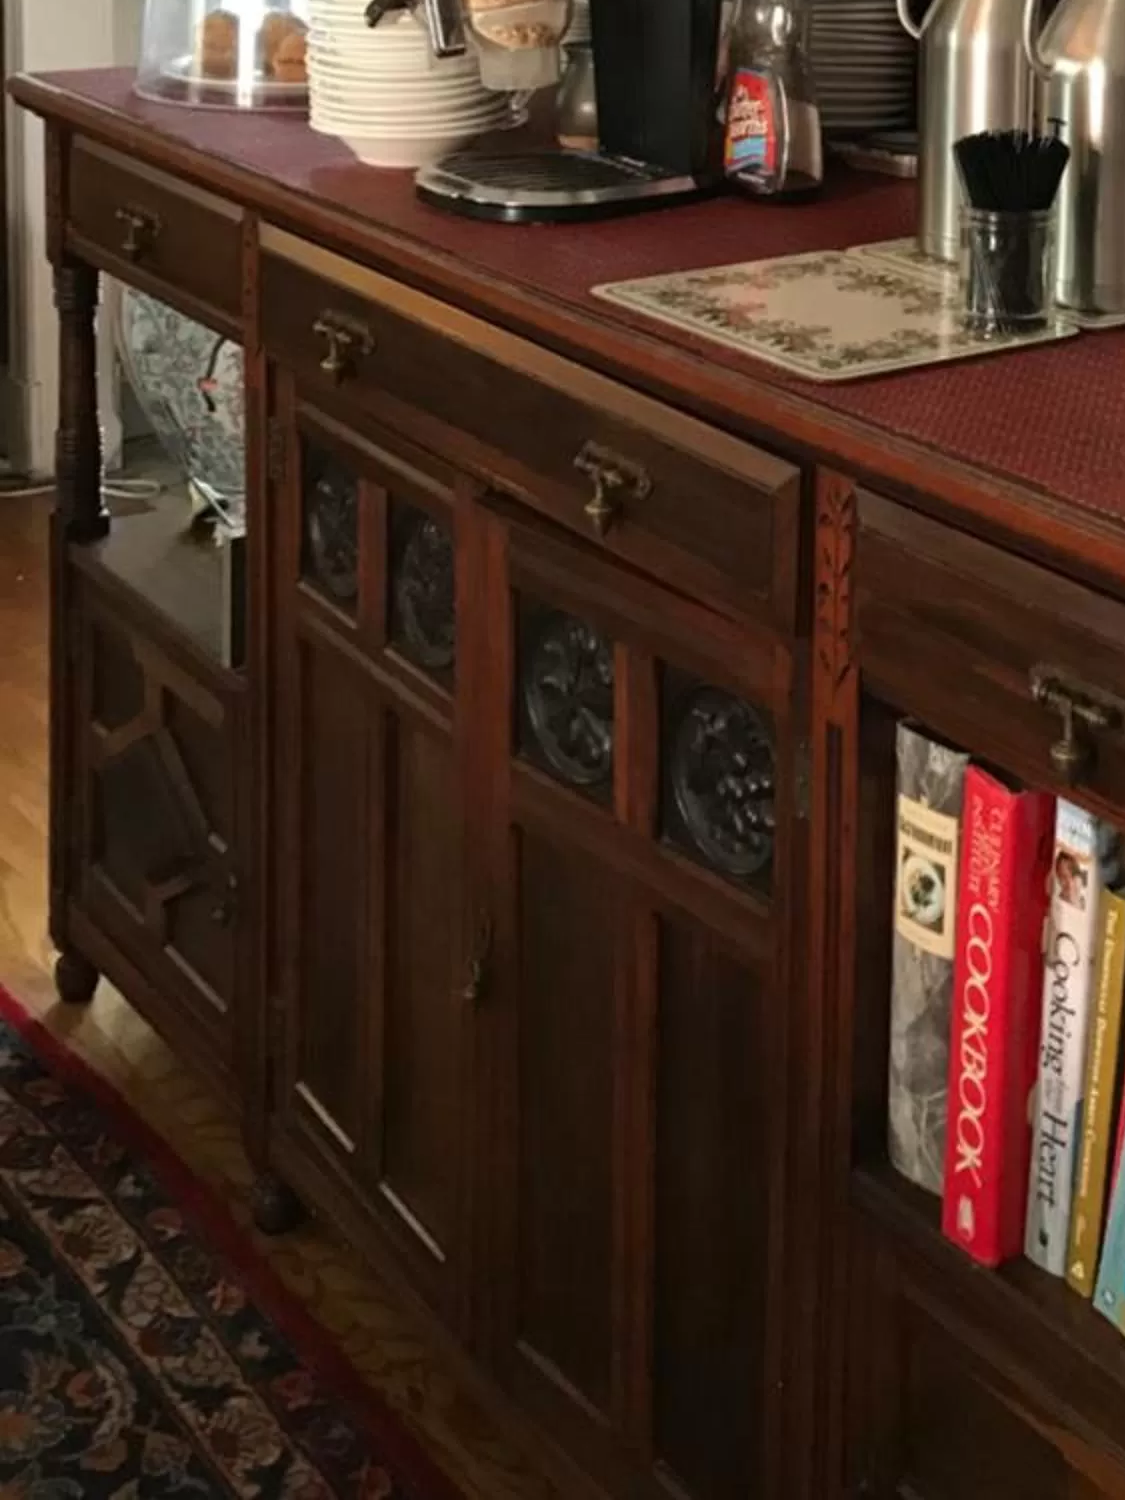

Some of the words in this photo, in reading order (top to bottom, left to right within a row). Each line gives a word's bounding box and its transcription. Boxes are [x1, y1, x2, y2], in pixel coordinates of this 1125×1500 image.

[955, 903, 993, 1188] COOKBOOK
[1042, 932, 1080, 1069] Cooking
[1036, 1110, 1068, 1206] Heart
